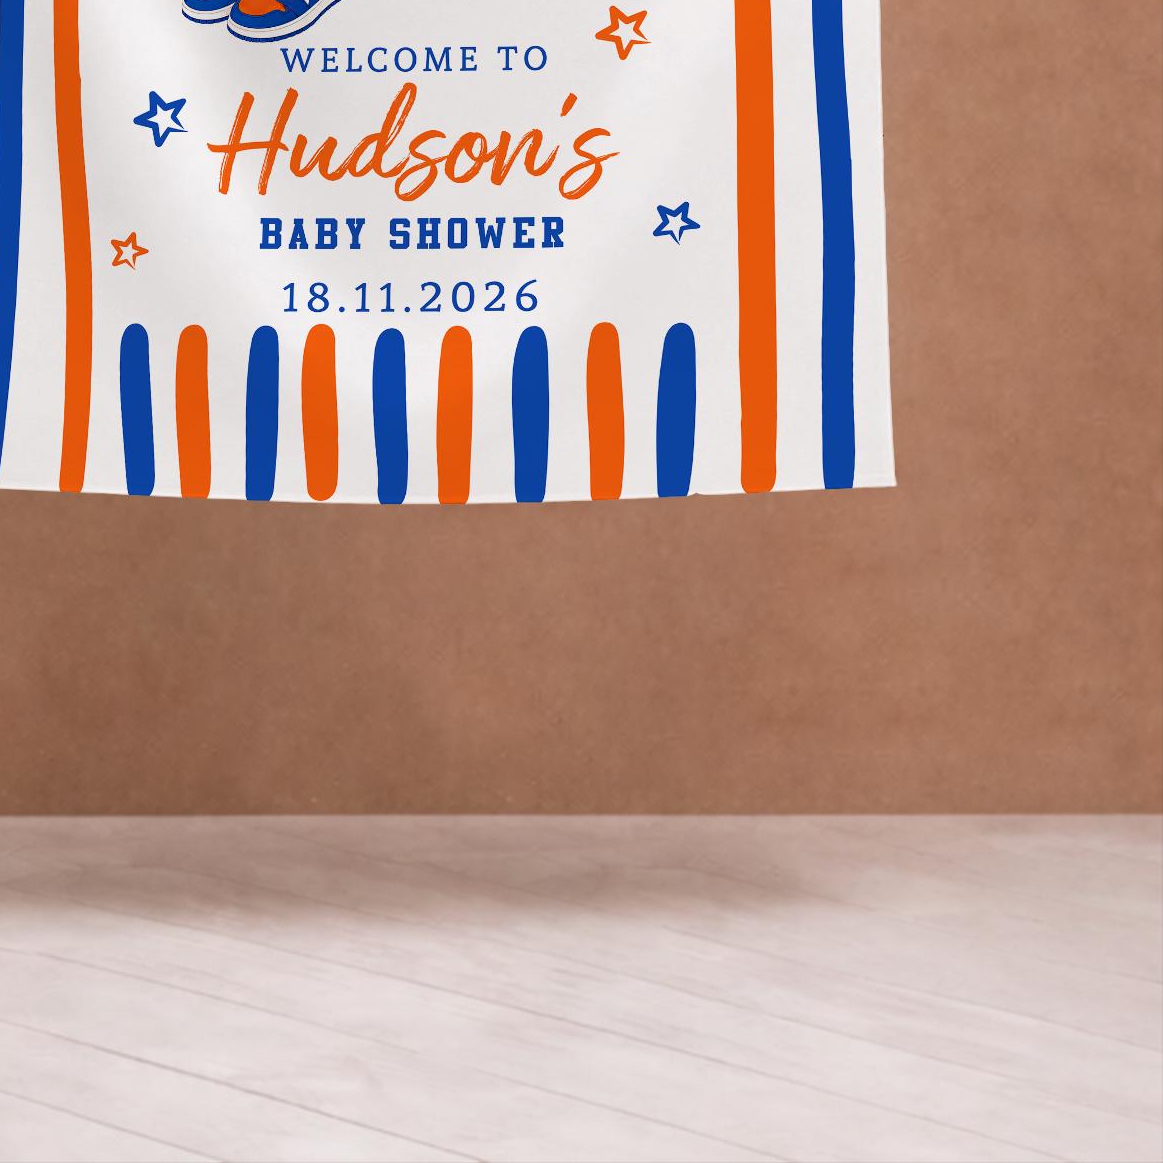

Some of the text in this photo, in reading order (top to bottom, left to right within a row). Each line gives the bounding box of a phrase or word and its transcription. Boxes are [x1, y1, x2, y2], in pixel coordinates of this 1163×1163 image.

[280, 45, 548, 73] WELCOME TO
[207, 82, 619, 202] Hudson's
[260, 216, 564, 250] BABY SHOWER
[282, 279, 538, 313] 18.11.2026
